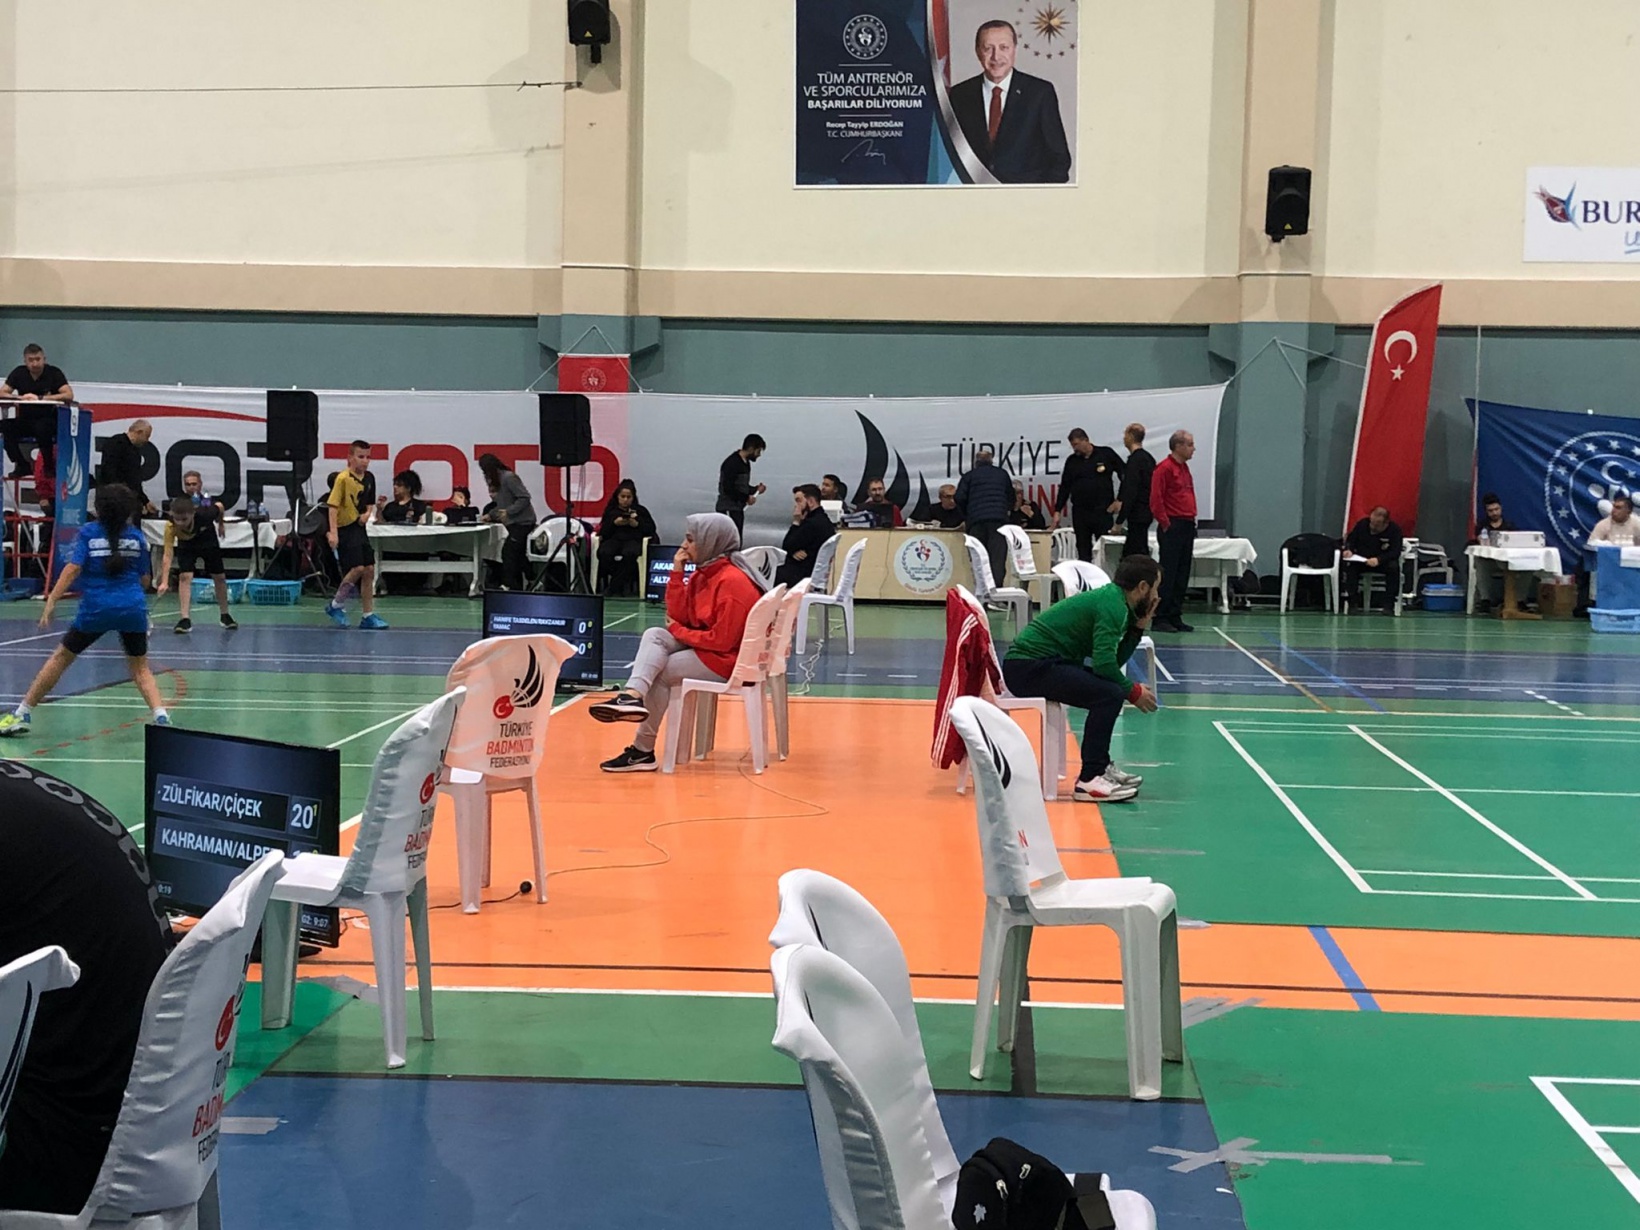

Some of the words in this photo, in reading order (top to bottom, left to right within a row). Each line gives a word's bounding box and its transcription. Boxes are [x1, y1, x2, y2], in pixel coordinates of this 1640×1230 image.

[817, 71, 844, 84] TÜM
[847, 71, 913, 84] ANTRENÖR
[803, 85, 819, 96] VE
[821, 85, 927, 96] SPORCULARIMIZA
[807, 99, 864, 110] BAŞARILAR
[865, 97, 922, 108] DİLİYORUM
[578, 621, 587, 634] 0
[578, 642, 586, 655] 0
[162, 783, 263, 820] ZÜLFİKAR/ÇİÇEK
[291, 803, 313, 829] 20
